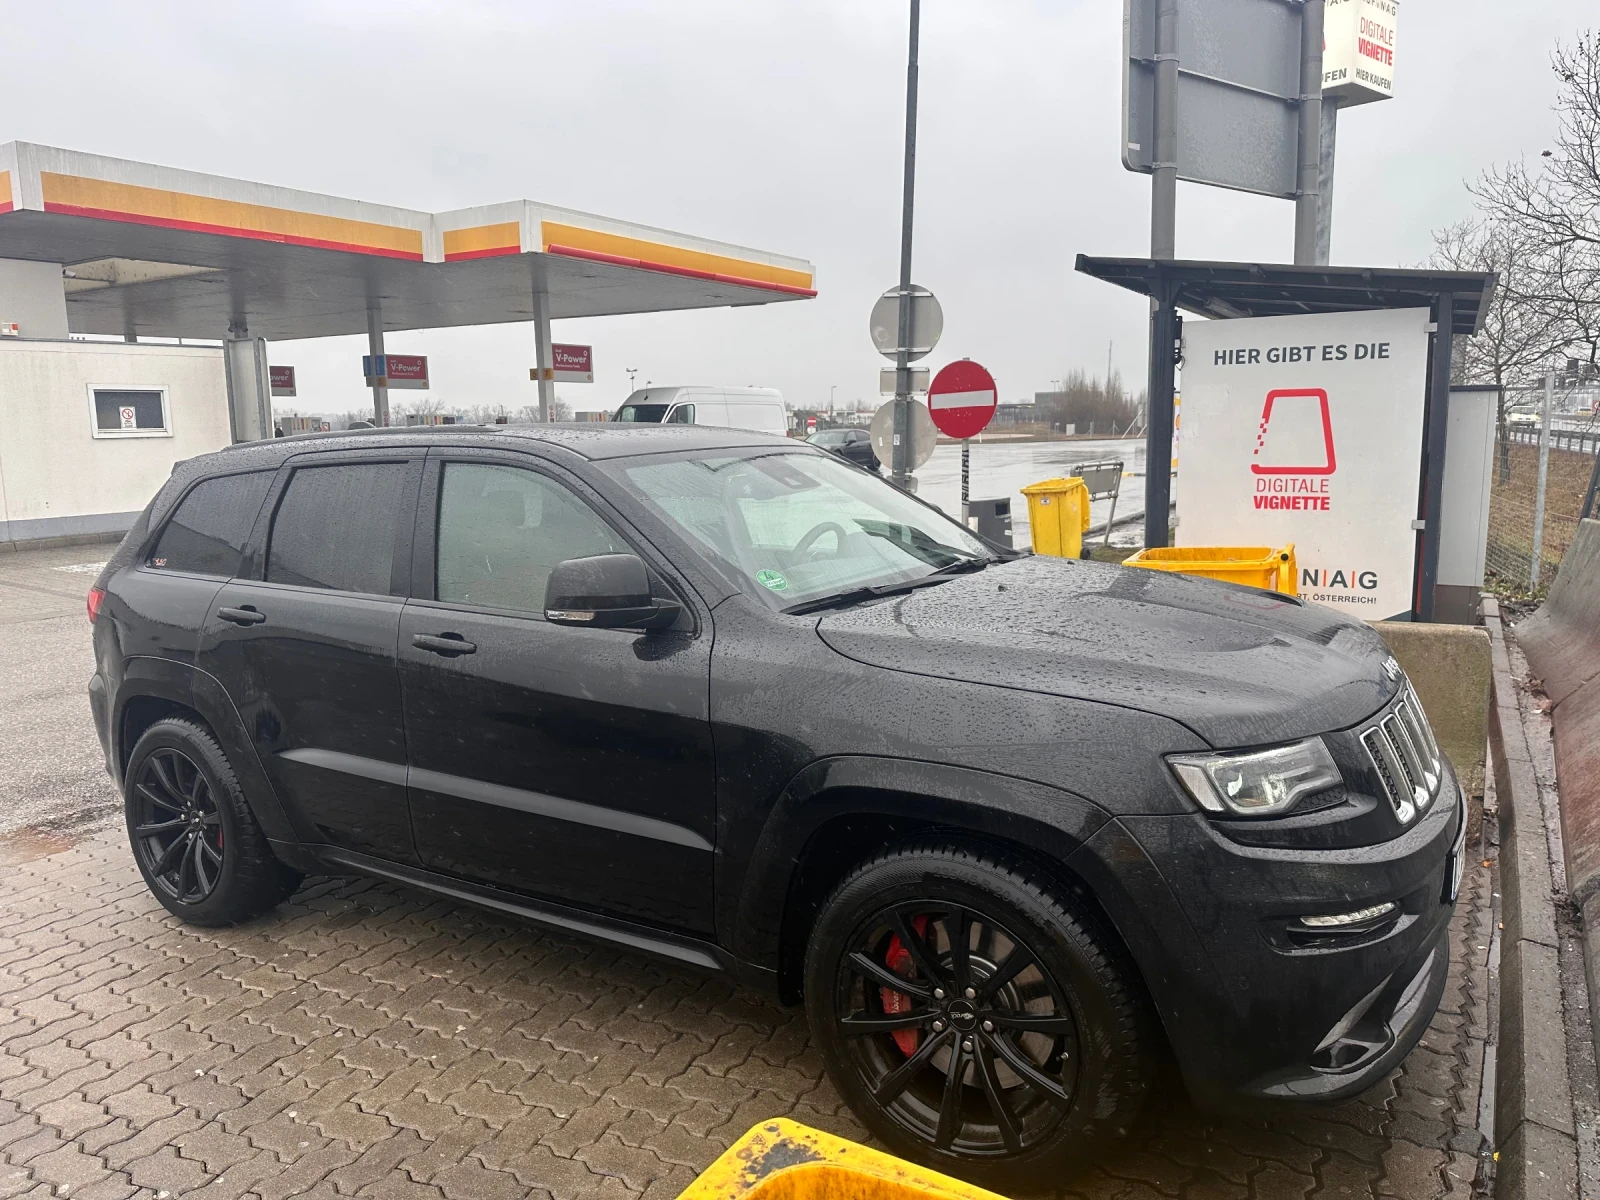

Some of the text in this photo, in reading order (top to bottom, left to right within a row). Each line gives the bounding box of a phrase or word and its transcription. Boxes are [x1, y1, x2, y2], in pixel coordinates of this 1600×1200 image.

[1360, 16, 1394, 47] DIGITALE
[1358, 36, 1393, 67] VIGNETTE
[1322, 67, 1348, 83] FEN
[1355, 67, 1392, 91] HIER KAUFEN
[555, 353, 587, 364] V-Power
[1213, 342, 1390, 366] HIER GIBT ES DIE
[390, 363, 421, 372] V-Power
[1256, 478, 1329, 493] DIGITALE
[1253, 495, 1331, 511] VIGNETTE
[1312, 592, 1377, 605] ÖSTERREICH!
